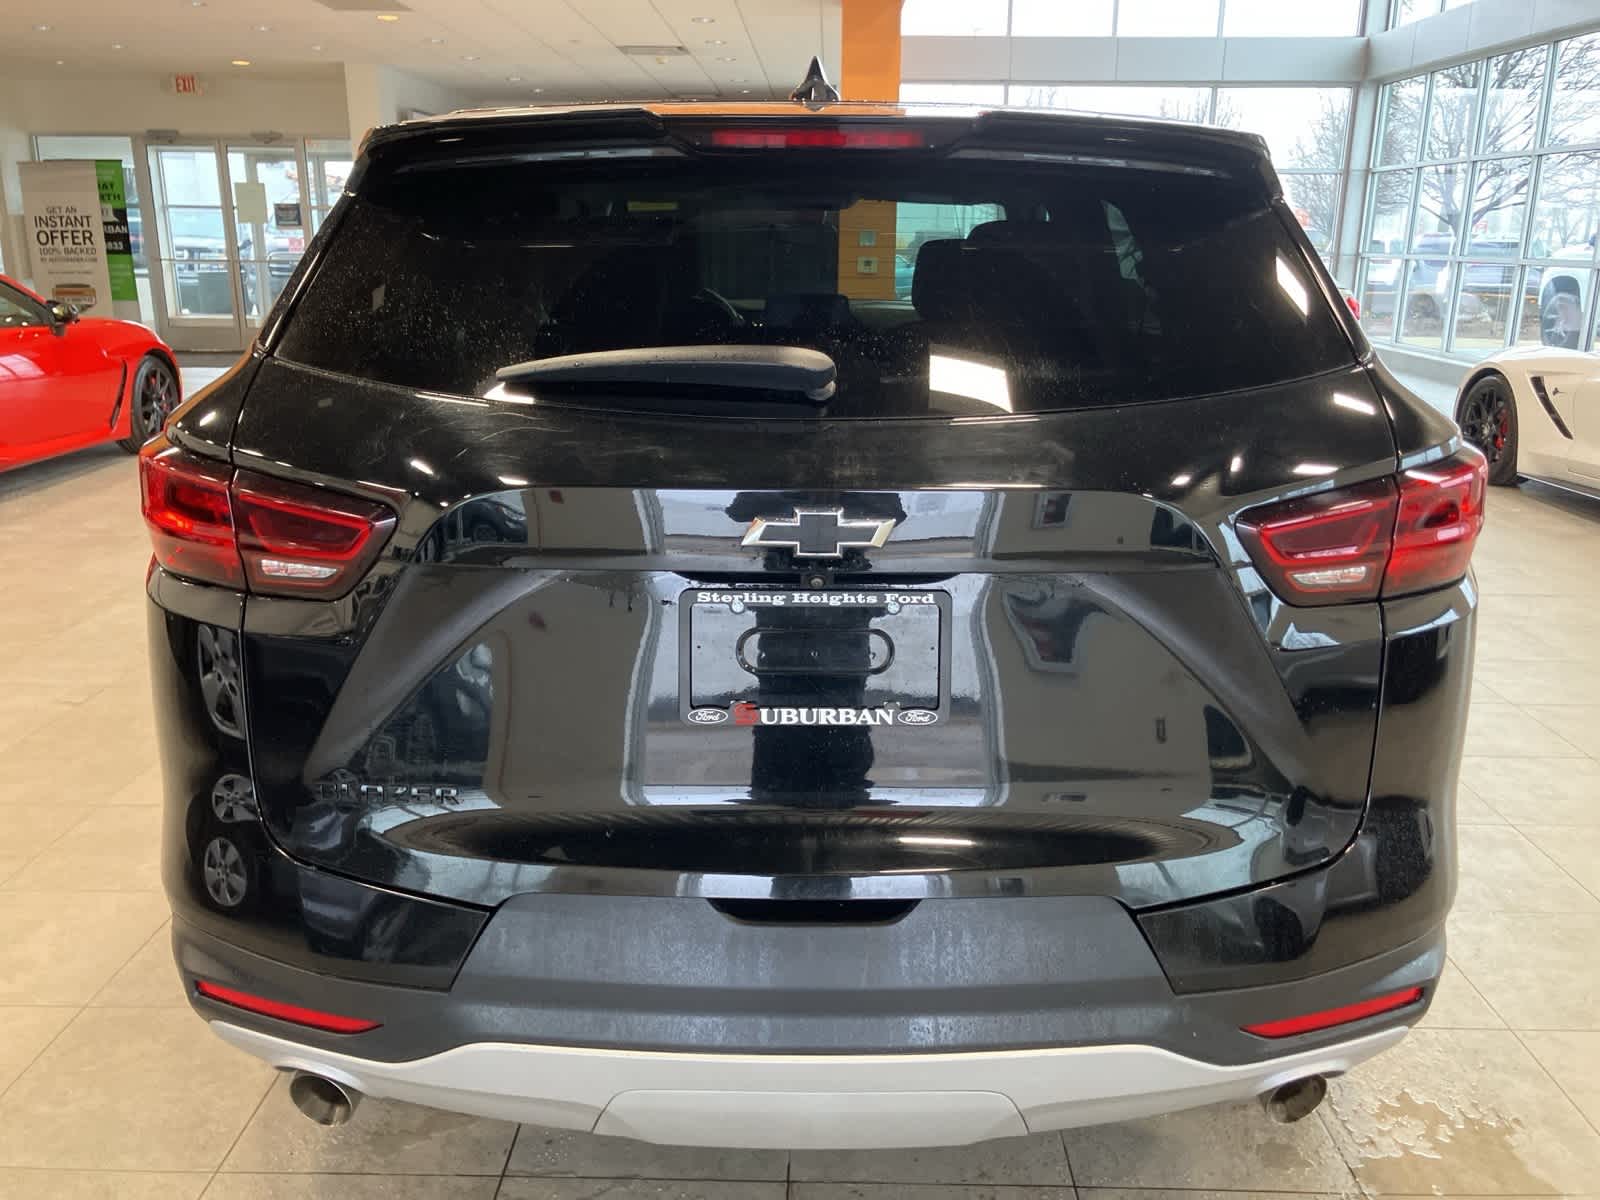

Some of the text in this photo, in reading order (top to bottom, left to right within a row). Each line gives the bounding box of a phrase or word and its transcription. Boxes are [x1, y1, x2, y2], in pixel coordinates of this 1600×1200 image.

[175, 74, 196, 93] EXIT
[46, 206, 77, 214] GET AN
[34, 215, 92, 228] INSTANT
[36, 230, 94, 246] OFFER
[39, 247, 96, 256] 100% BACKED
[697, 592, 935, 605] Sterling Heights Ford
[733, 702, 895, 726] SUBURBAN
